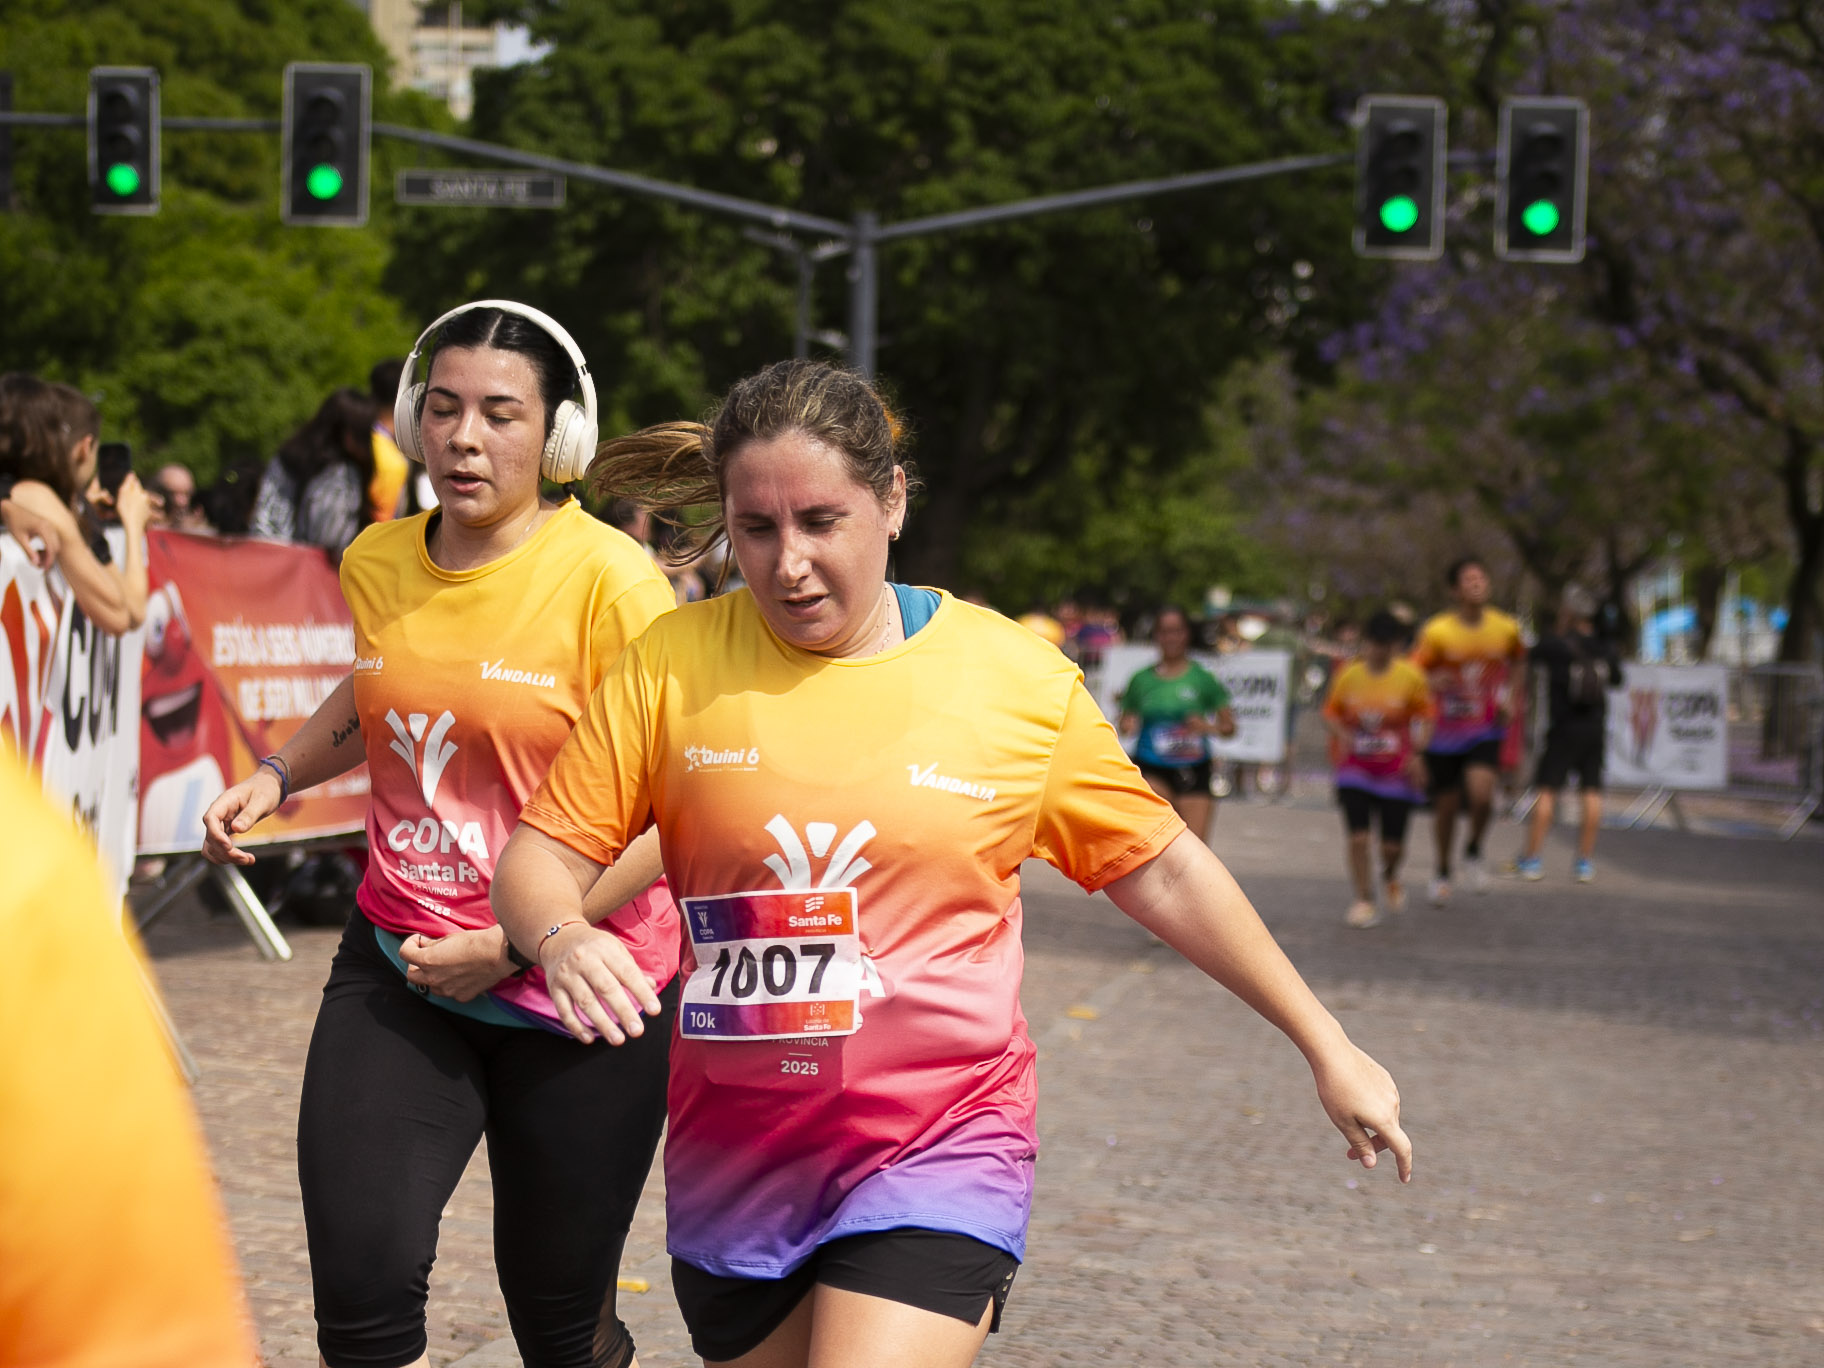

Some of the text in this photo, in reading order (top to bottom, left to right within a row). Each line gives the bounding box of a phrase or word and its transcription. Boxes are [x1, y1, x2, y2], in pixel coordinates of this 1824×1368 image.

[376, 656, 383, 670] 6
[702, 747, 759, 765] Quini 6
[387, 818, 489, 859] COPA
[396, 860, 479, 883] Santa Fe
[788, 913, 843, 928] Santa Fe
[711, 944, 836, 998] 1007
[690, 1012, 716, 1028] 10k
[781, 1060, 819, 1075] 2025
